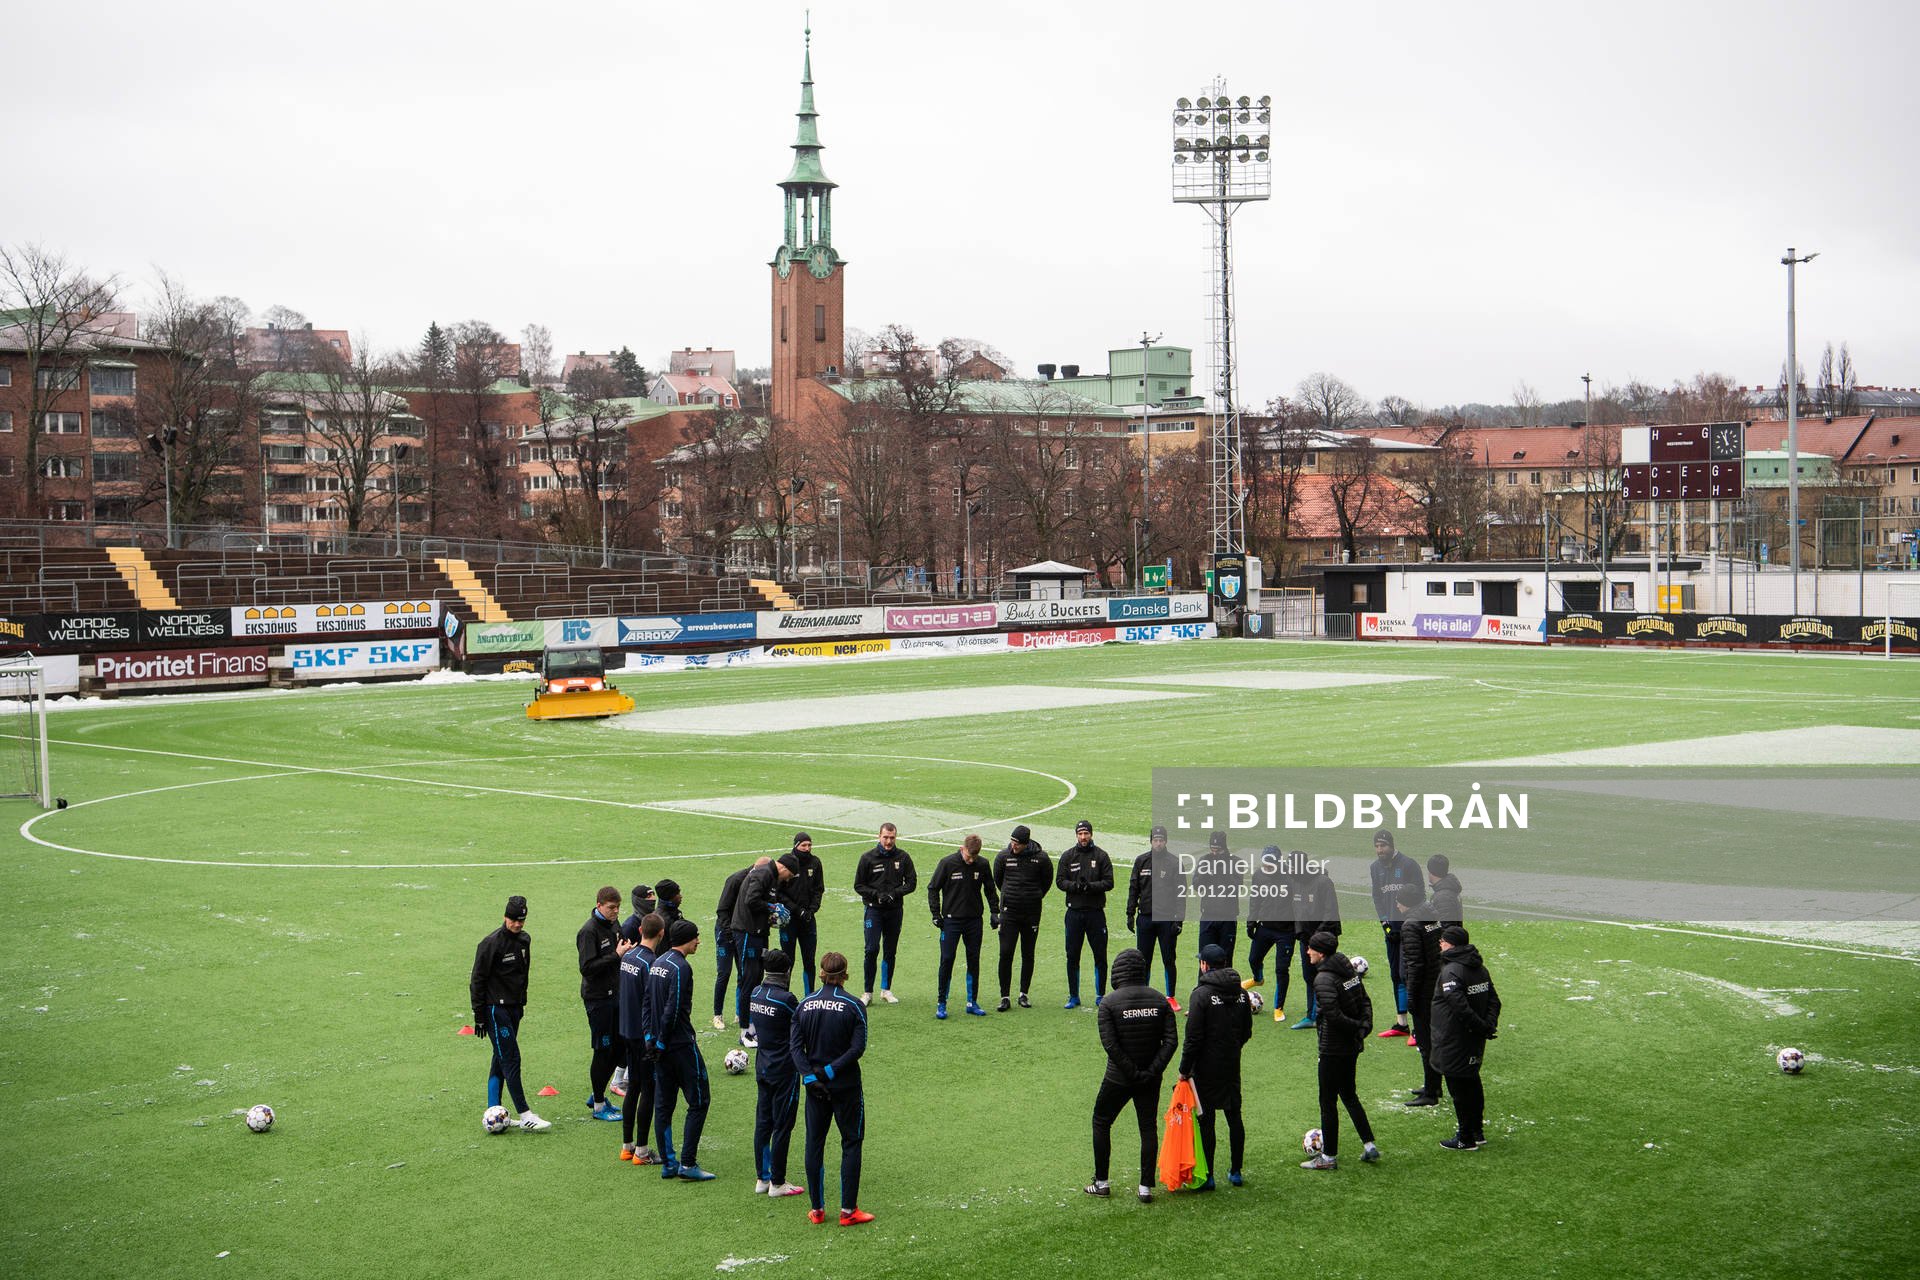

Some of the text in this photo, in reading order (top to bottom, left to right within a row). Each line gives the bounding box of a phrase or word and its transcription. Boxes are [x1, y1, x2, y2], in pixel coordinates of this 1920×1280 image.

[1652, 428, 1708, 440] H G
[1623, 468, 1630, 478] A
[1652, 467, 1658, 478] C
[1682, 466, 1688, 477] E
[1712, 465, 1719, 476] G
[1623, 487, 1629, 498] B
[1652, 486, 1658, 497] D
[1682, 486, 1688, 496] F
[1712, 485, 1720, 496] H
[1005, 603, 1035, 620] Buds
[1038, 604, 1047, 618] &
[1122, 601, 1202, 616] Danske Bank
[61, 617, 117, 629] NORDIC
[160, 614, 211, 626] NORDIC
[384, 616, 432, 629] EKSJÖHUS
[893, 610, 992, 626] ICA FOCUS 7-23
[147, 624, 224, 637] WELLNESS
[245, 620, 297, 635] EKSJÖHUS
[316, 618, 366, 632] EKSJÖHUS
[562, 620, 592, 642] HTC
[1423, 618, 1472, 633] Heja alla!
[1557, 618, 1603, 634] KOPPARBERG
[1626, 620, 1674, 636] KOPPARBERG
[1697, 620, 1748, 638] KOPPARBERG
[1780, 622, 1833, 639] KOPPARBERG
[48, 628, 130, 640] WELLNESS
[627, 630, 675, 642] ARROW
[1126, 624, 1206, 641] SKF SKF
[293, 644, 433, 668] SKF SKF
[98, 652, 266, 679] Prioritet Finans
[750, 1002, 776, 1016] ERNEKE
[804, 1000, 845, 1012] SERNEKE
[1122, 1008, 1158, 1019] SERNEKE
